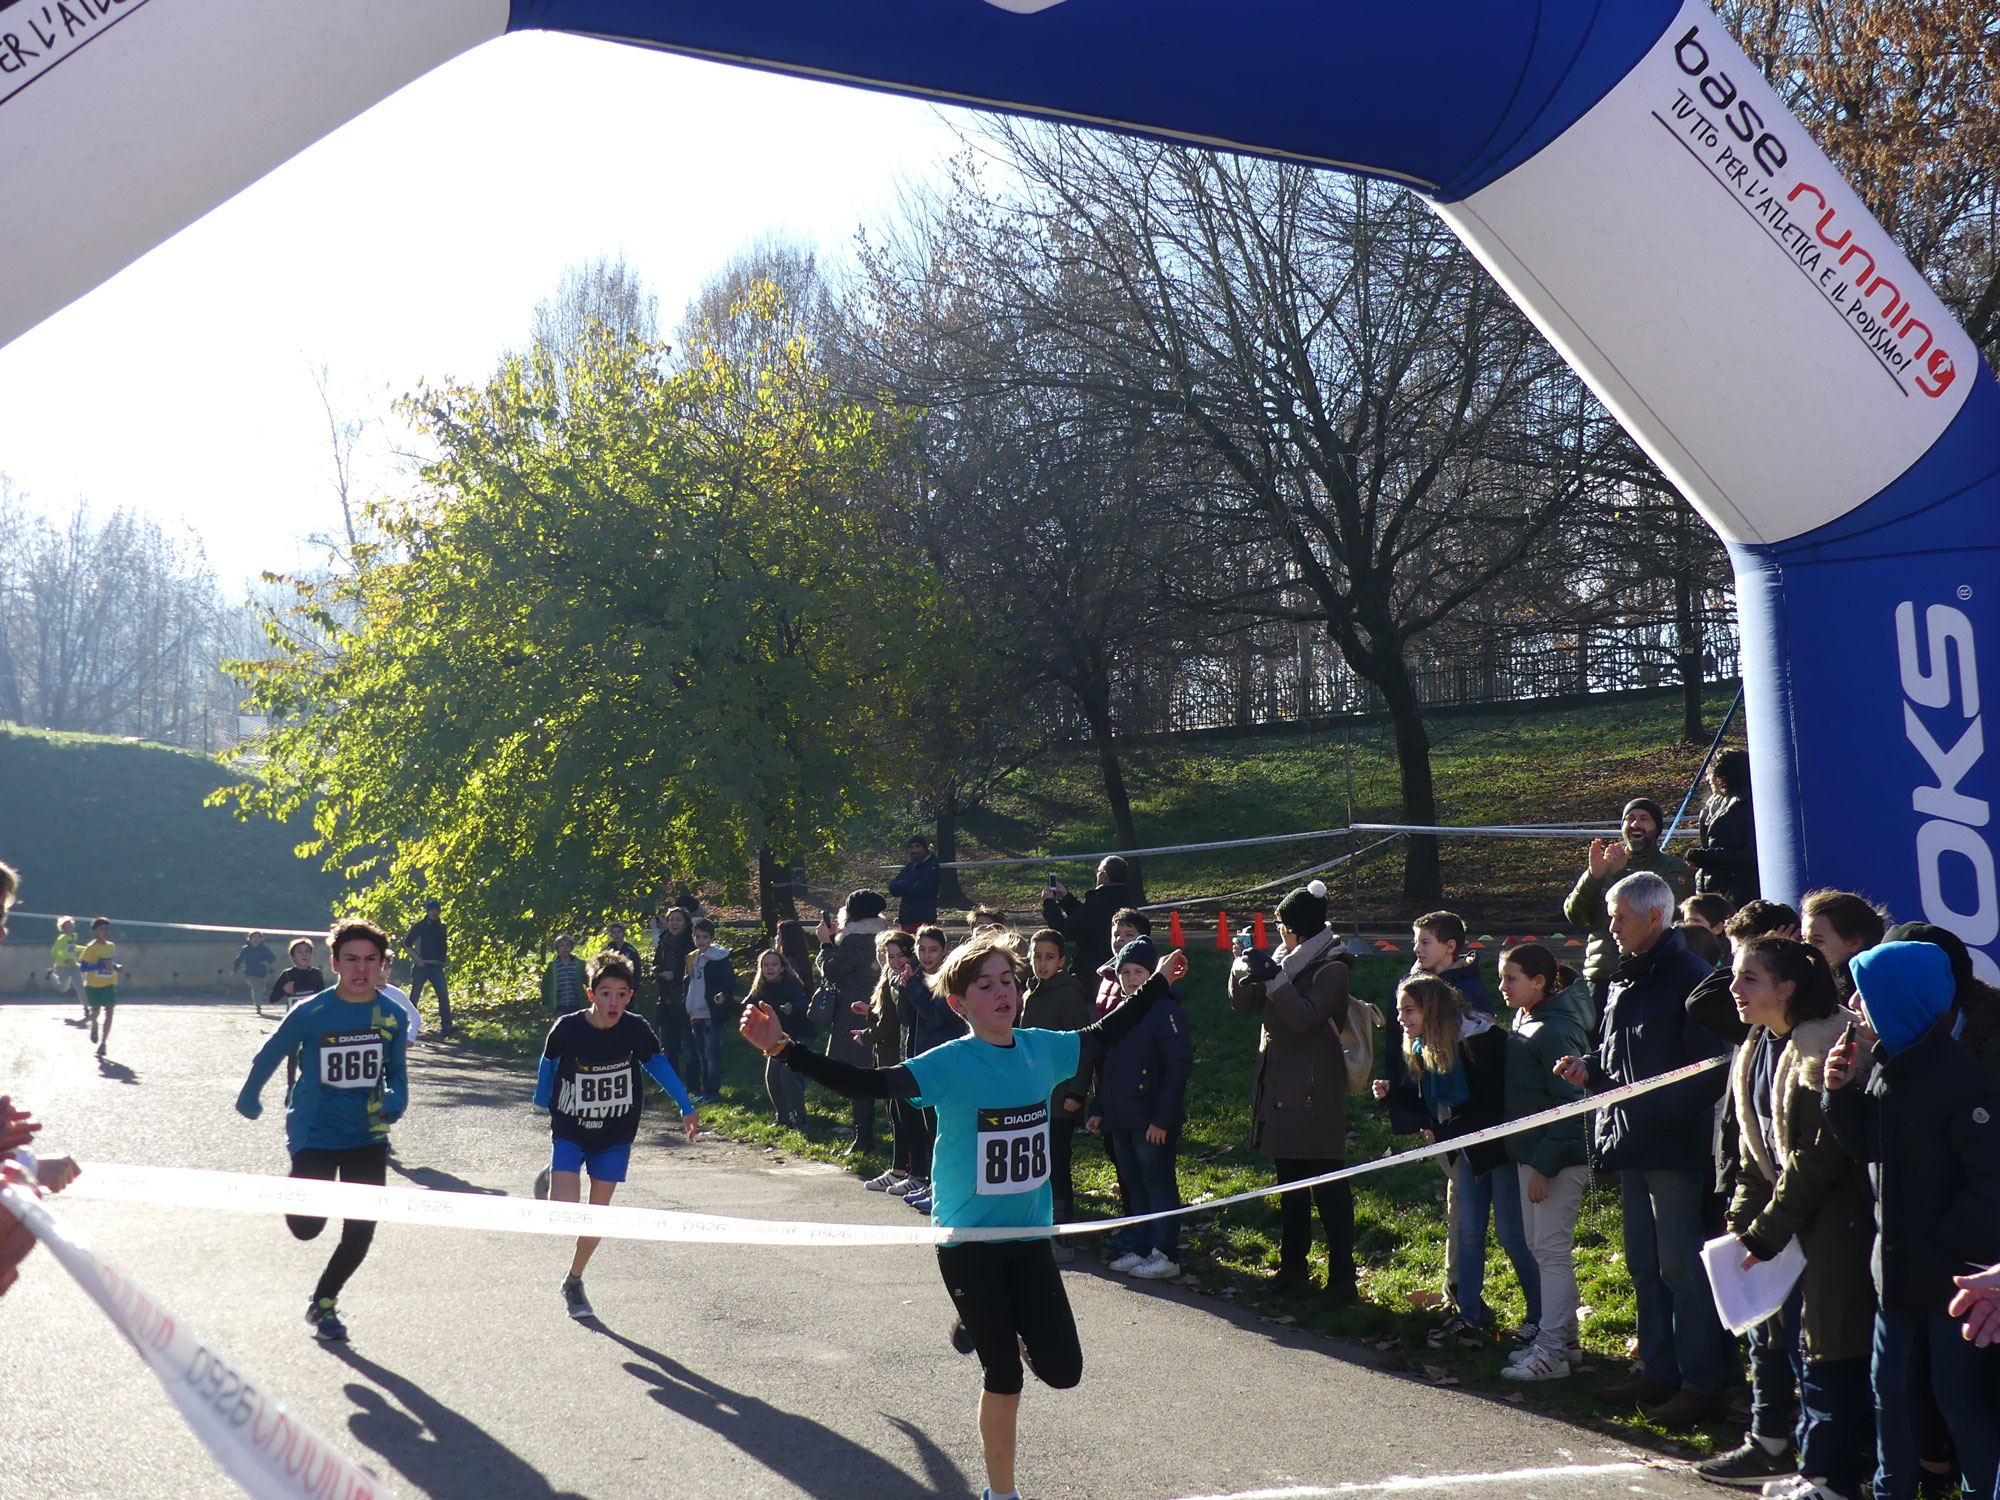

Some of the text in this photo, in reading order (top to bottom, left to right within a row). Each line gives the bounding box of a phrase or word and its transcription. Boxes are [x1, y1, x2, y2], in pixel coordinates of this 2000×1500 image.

[1674, 25, 1956, 398] base running
[1671, 87, 1912, 375] TUTTO PER L'ATLETICA E IL PODISMO!
[1895, 600, 2000, 990] OKS
[339, 1033, 381, 1043] DIADORA
[327, 1049, 379, 1082] 866
[592, 1060, 630, 1072] DIADORA
[581, 1073, 628, 1102] 869
[1003, 1108, 1047, 1125] DIADORA
[985, 1131, 1047, 1184] 868
